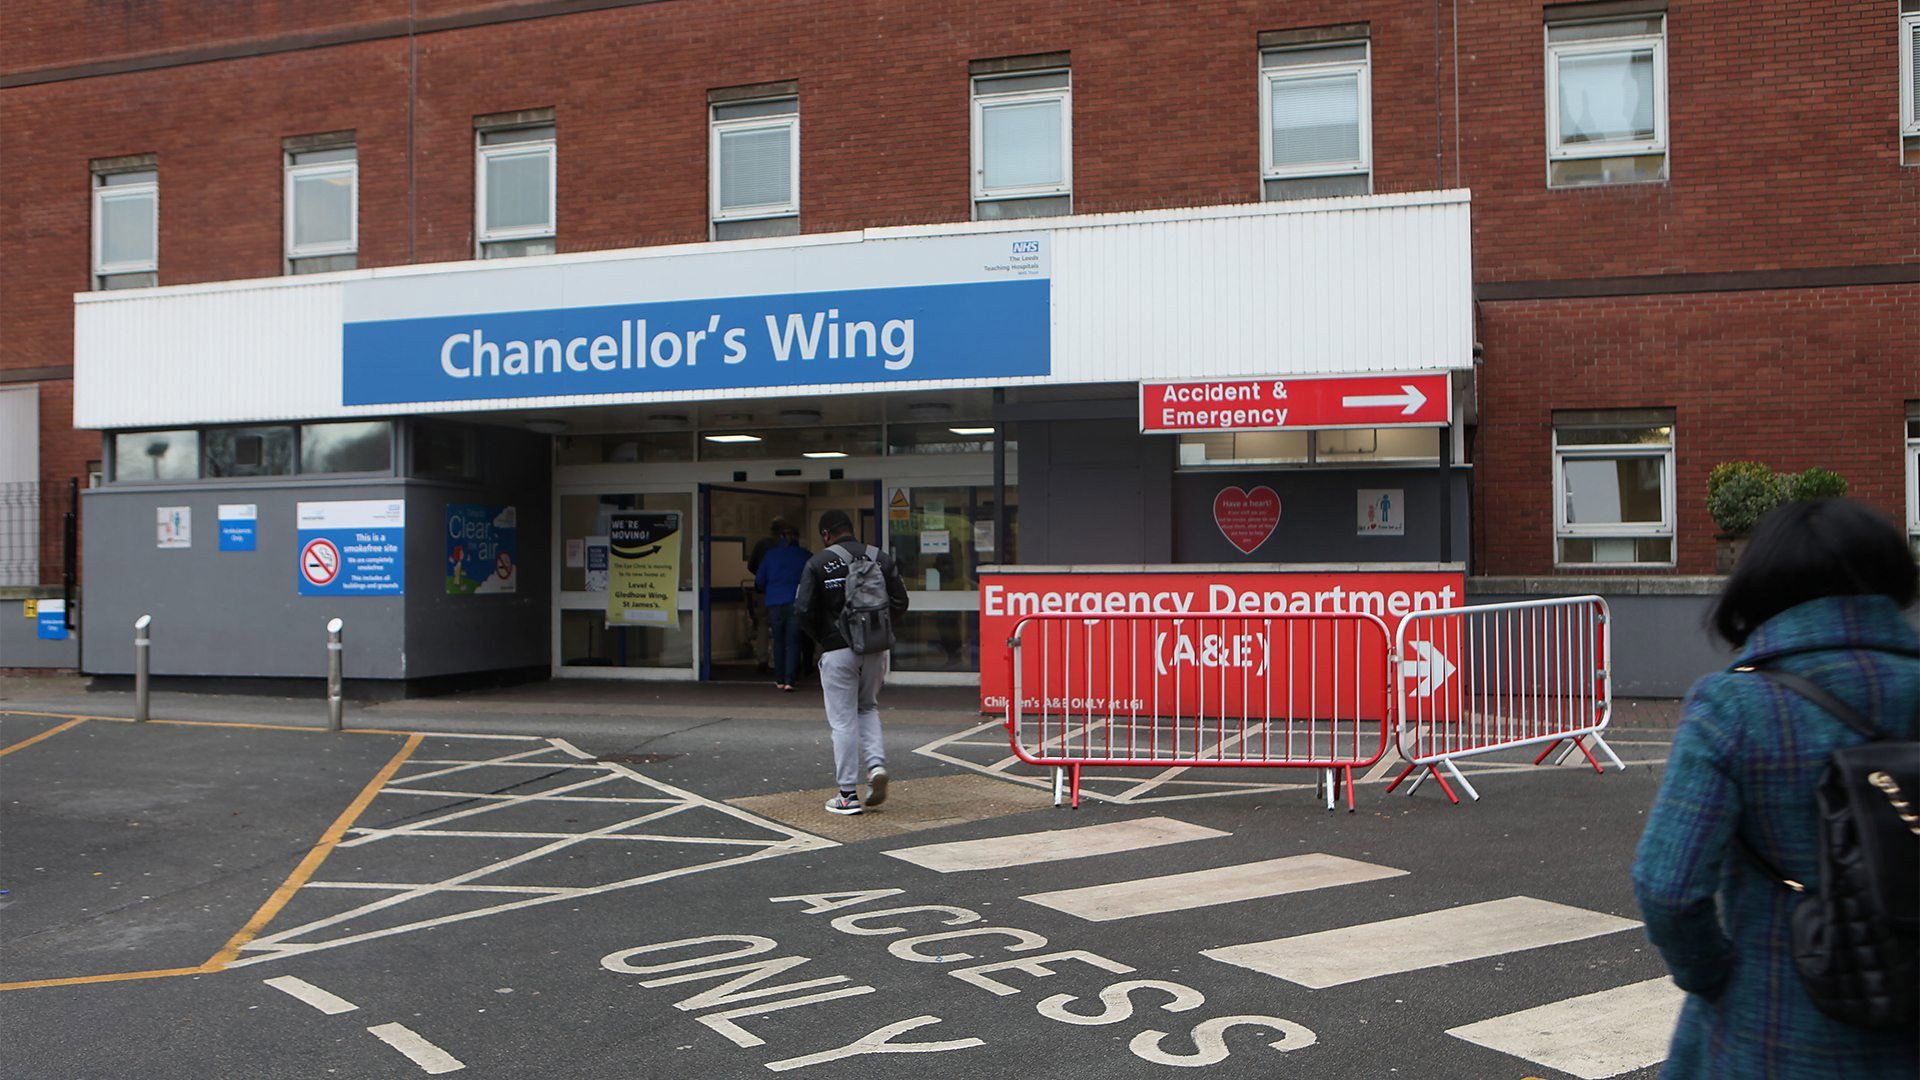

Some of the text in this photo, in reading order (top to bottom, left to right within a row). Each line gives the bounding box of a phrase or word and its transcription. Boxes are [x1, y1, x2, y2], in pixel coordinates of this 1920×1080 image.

[1013, 241, 1038, 253] NHS
[1012, 262, 1039, 270] Hospitals
[441, 309, 915, 378] Chancellor’s Wing
[1163, 381, 1287, 402] Accident &
[1162, 407, 1288, 427] Emergency
[449, 515, 490, 539] Clear
[612, 520, 639, 529] WE'RE
[356, 533, 371, 541] This
[372, 533, 379, 541] is
[612, 531, 650, 540] MOVING!
[344, 543, 398, 552] smokefree site
[478, 542, 498, 560] air
[615, 591, 646, 599] Gledhow
[985, 584, 1456, 625] Emergency Department
[1155, 632, 1271, 676] (A&E)
[984, 696, 1040, 708] Chiln's
[769, 888, 1318, 1068] ACCESS
[600, 934, 987, 1073] ONLY
